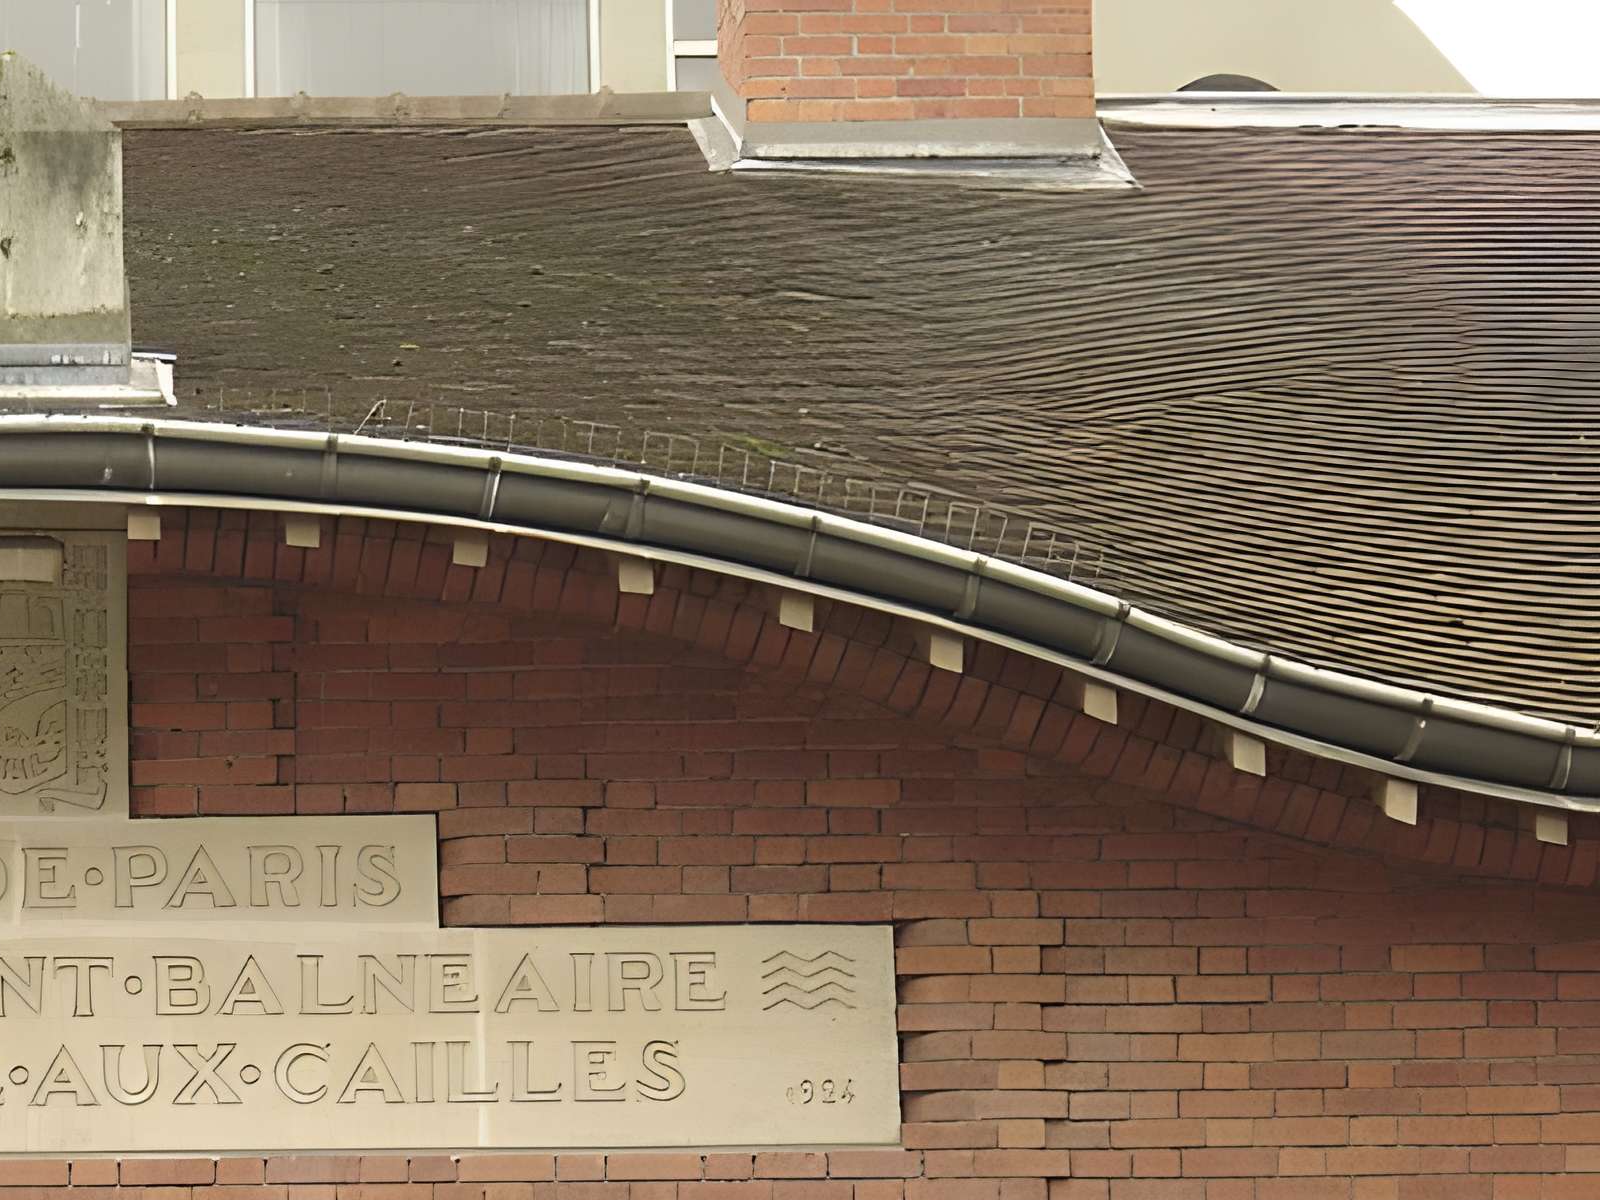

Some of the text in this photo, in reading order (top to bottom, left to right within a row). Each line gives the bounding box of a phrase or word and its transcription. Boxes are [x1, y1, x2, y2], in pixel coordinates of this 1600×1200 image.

[114, 844, 401, 909] PARIS
[153, 952, 728, 1015] BALNEAIRE
[30, 1043, 242, 1106] AUX
[273, 1040, 687, 1104] CAILLES
